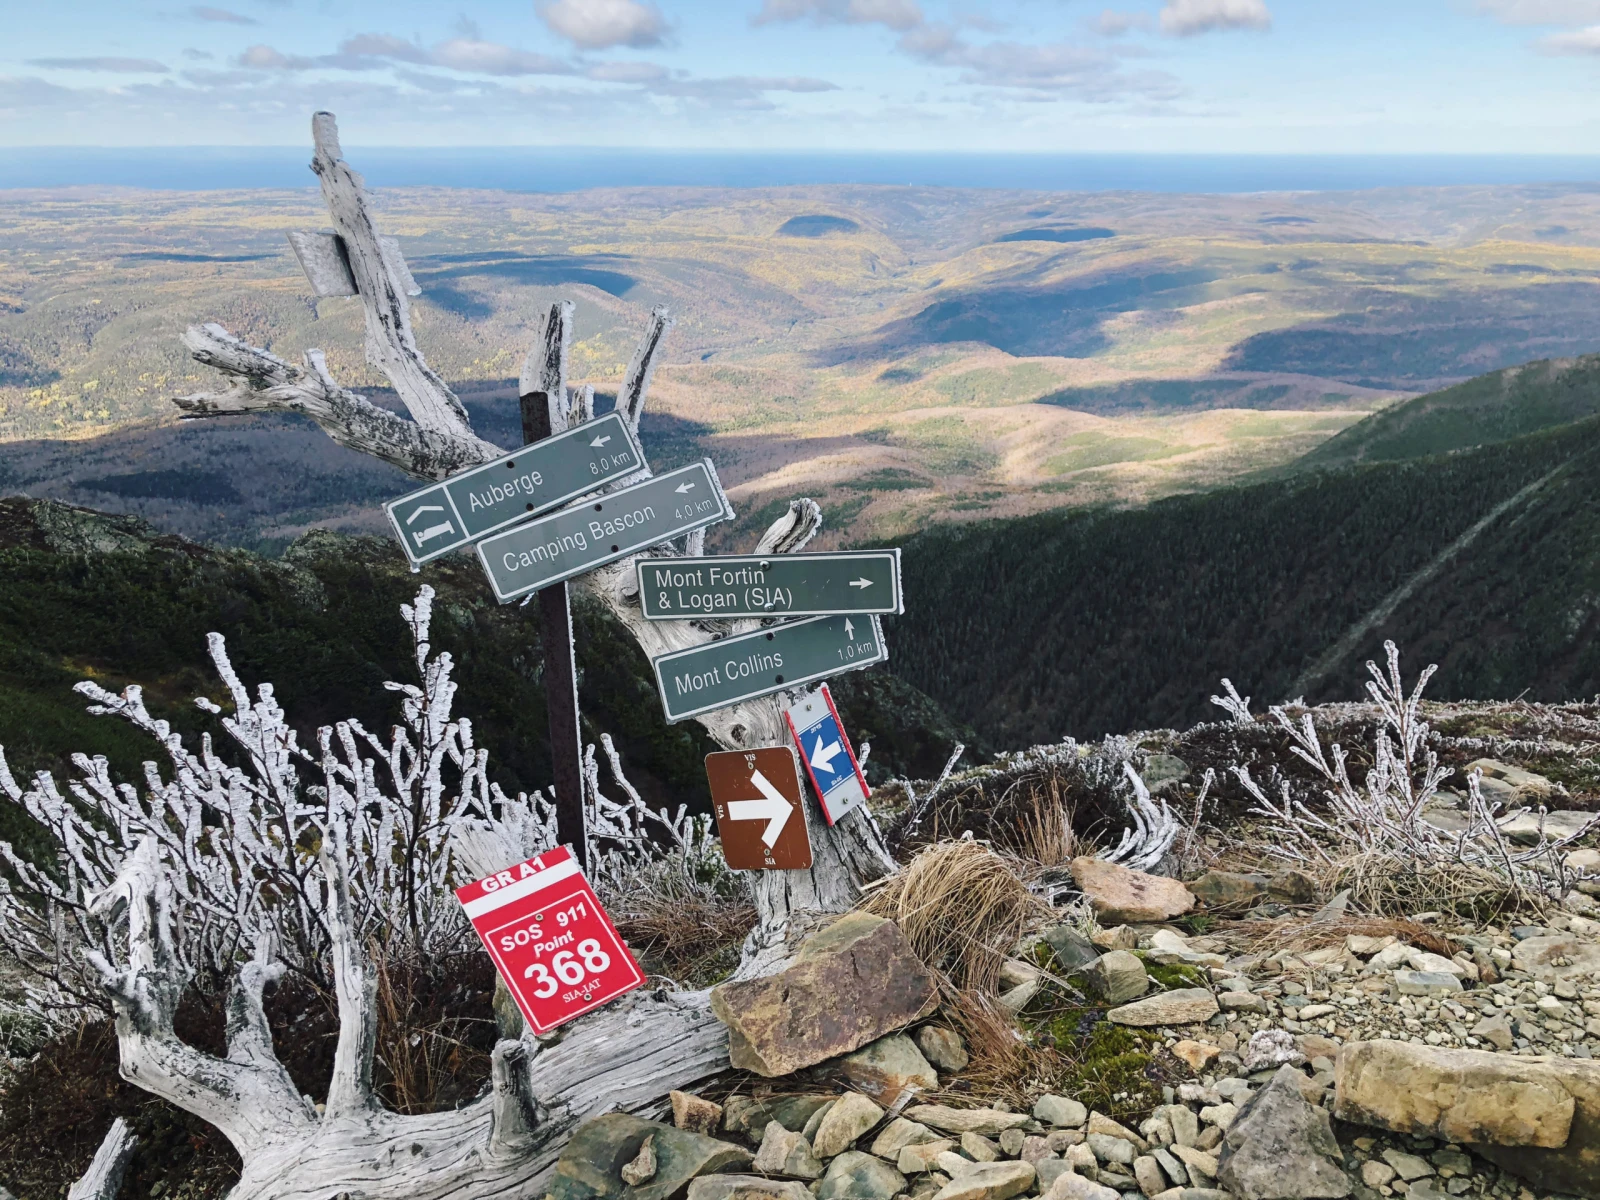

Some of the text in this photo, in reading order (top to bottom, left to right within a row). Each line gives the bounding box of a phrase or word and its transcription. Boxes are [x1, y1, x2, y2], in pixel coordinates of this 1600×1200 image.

[589, 451, 631, 476] 8,0 km
[468, 470, 544, 512] Auberge
[675, 497, 713, 521] 4,0 km
[502, 505, 656, 572] Camping Bascon
[655, 567, 765, 588] Mont Fortin
[658, 587, 793, 612] & Logan (SIA)
[837, 641, 873, 661] 1,0 km
[674, 652, 784, 696] Mont Collins
[481, 857, 546, 893] GR A1
[500, 902, 587, 952] SOS 911
[533, 929, 575, 957] Point
[524, 938, 611, 999] 368
[562, 978, 602, 1003] SIA-IAT
